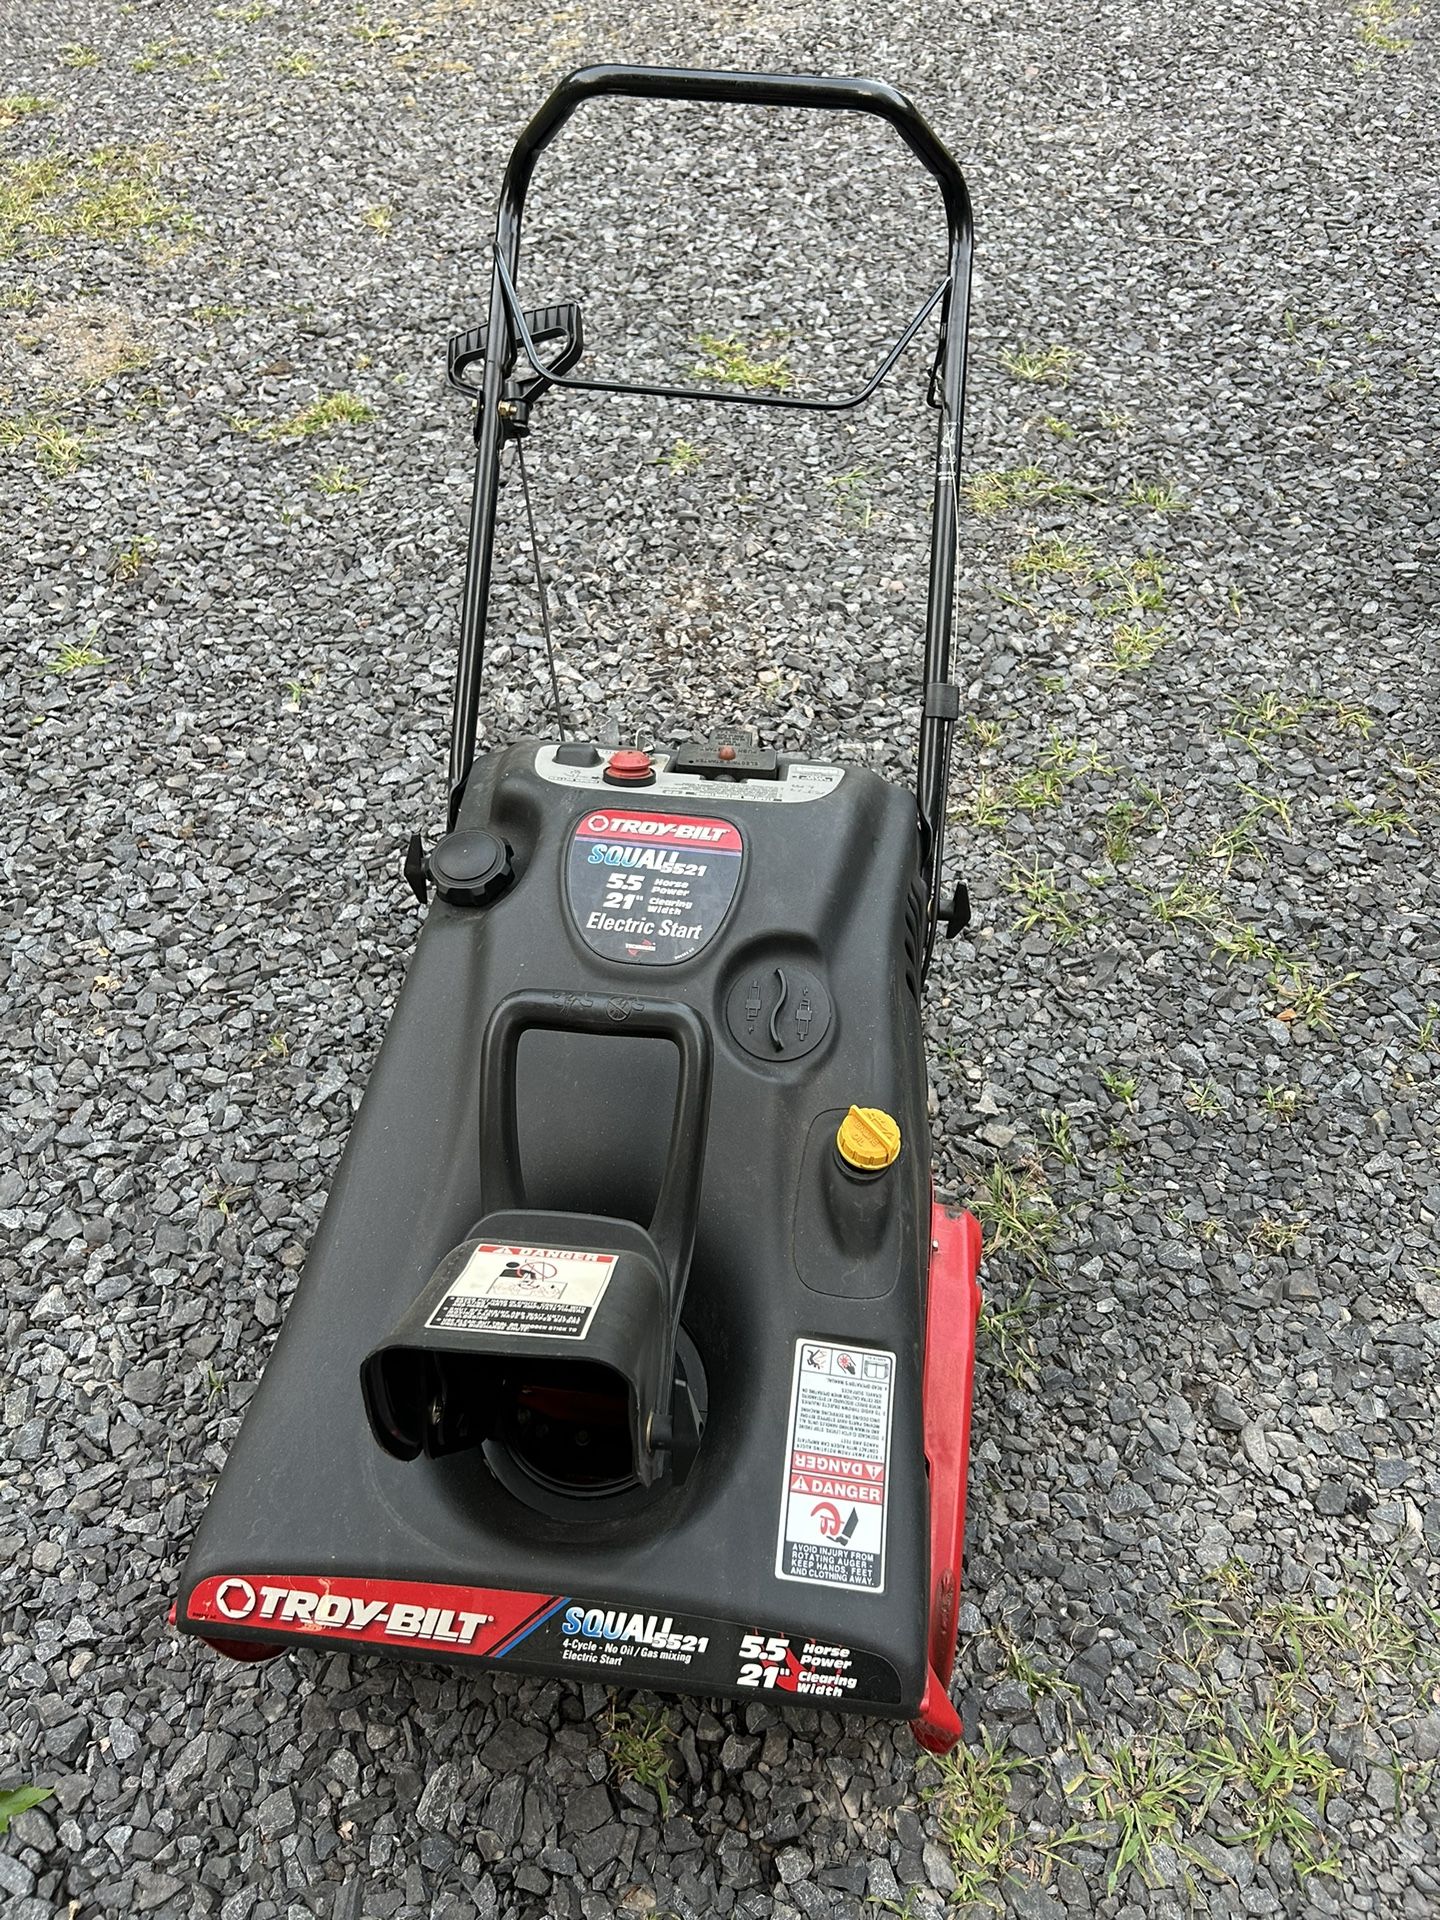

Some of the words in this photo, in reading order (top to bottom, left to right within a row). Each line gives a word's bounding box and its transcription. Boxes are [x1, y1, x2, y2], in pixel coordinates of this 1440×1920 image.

[609, 818, 730, 841] TROY-BILT
[660, 861, 707, 877] 5521
[606, 873, 645, 891] 5.5
[654, 879, 689, 888] Horse
[603, 892, 643, 910] 21"
[651, 887, 690, 897] Power
[647, 905, 682, 916] Width
[650, 897, 693, 909] Clearing
[586, 911, 655, 935] Electric
[658, 919, 702, 940] Start
[518, 1248, 598, 1263] DANGER
[795, 1454, 863, 1476] DANGER
[811, 1480, 881, 1501] DANGER
[792, 1543, 818, 1553] AVOID
[820, 1547, 850, 1558] INJURY
[850, 1551, 874, 1562] FROM
[792, 1551, 835, 1564] ROTATING
[841, 1558, 869, 1568] AUGER
[790, 1566, 808, 1575] AND
[808, 1568, 847, 1582] CLOTHING
[849, 1575, 875, 1586] AWAY.
[791, 1559, 814, 1569] KEEP
[851, 1567, 873, 1577] FEET
[259, 1586, 488, 1644] TROY-BILT
[562, 1638, 598, 1653] 4-Cycle
[604, 1643, 618, 1654] No
[619, 1645, 634, 1656] Oil
[640, 1648, 659, 1659] Gas
[659, 1651, 692, 1664] mixing
[652, 1631, 709, 1653] 5521
[738, 1634, 790, 1662] 5.5
[802, 1643, 850, 1658] Horse
[562, 1649, 598, 1663] Electric
[599, 1654, 622, 1666] Start
[800, 1654, 852, 1670] Power
[736, 1663, 790, 1689] 21"
[798, 1671, 857, 1689] Clearing
[797, 1682, 843, 1697] Width
